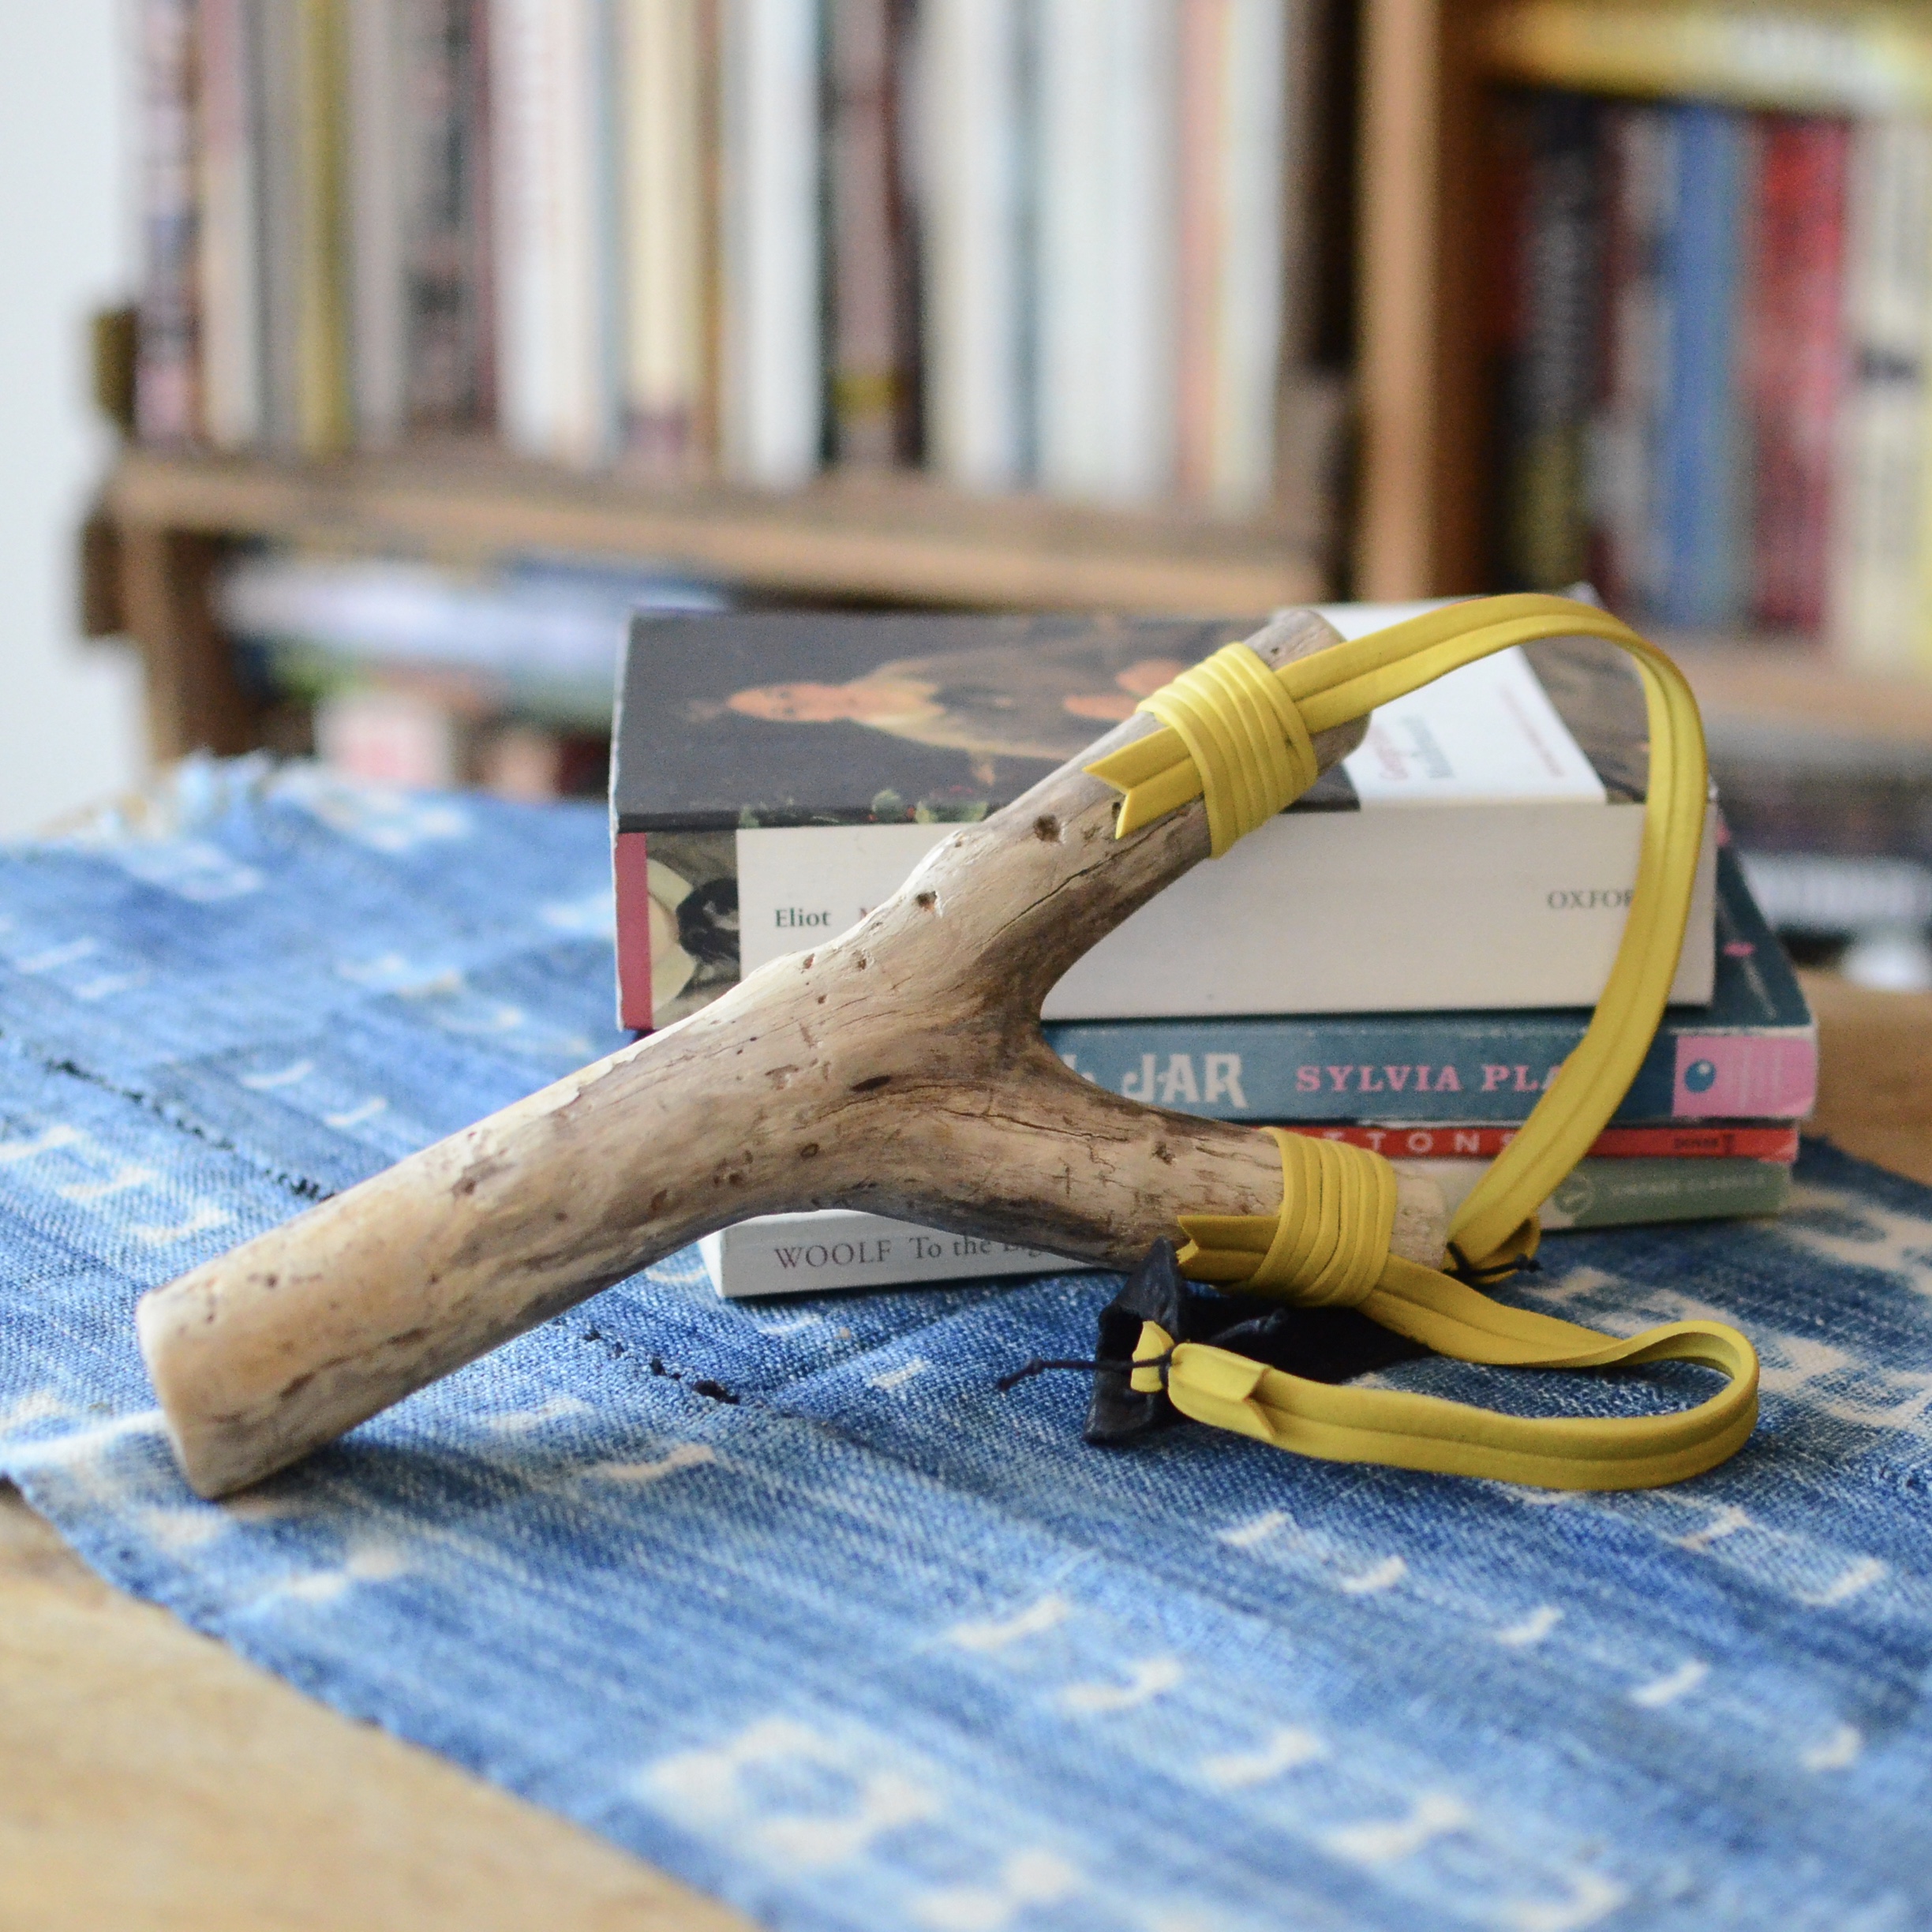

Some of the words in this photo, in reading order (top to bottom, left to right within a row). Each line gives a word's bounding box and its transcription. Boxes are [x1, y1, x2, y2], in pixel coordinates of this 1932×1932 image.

[775, 908, 830, 927] Eliot
[1121, 1053, 1248, 1108] JAR
[1296, 1065, 1462, 1092] SYLVIA
[773, 1239, 893, 1269] WOOLF
[908, 1236, 942, 1260] To
[953, 1235, 991, 1256] the
